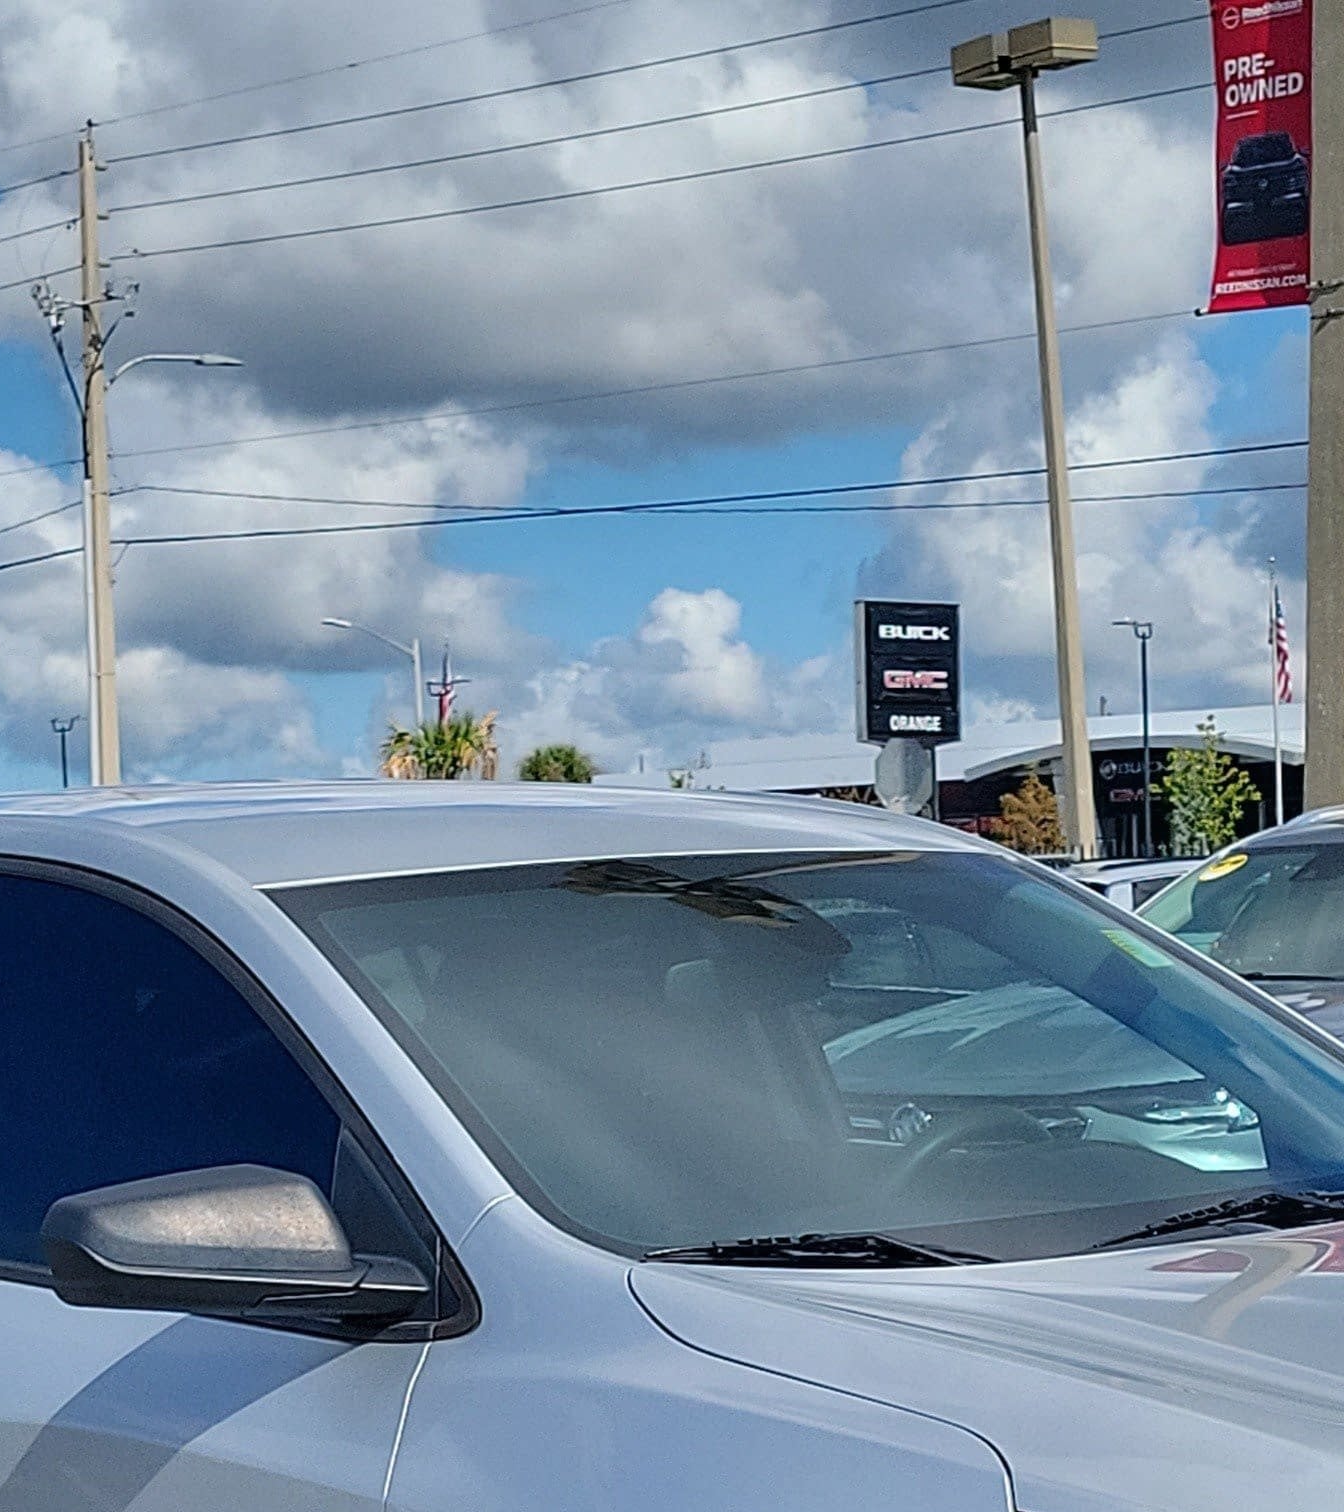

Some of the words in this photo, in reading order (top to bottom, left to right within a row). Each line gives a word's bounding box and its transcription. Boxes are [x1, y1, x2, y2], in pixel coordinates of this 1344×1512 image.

[1223, 53, 1275, 81] PRE-
[1225, 72, 1304, 107] OWNED
[878, 624, 950, 641] BUICK
[883, 670, 948, 689] GMC
[889, 715, 942, 731] ORANGE
